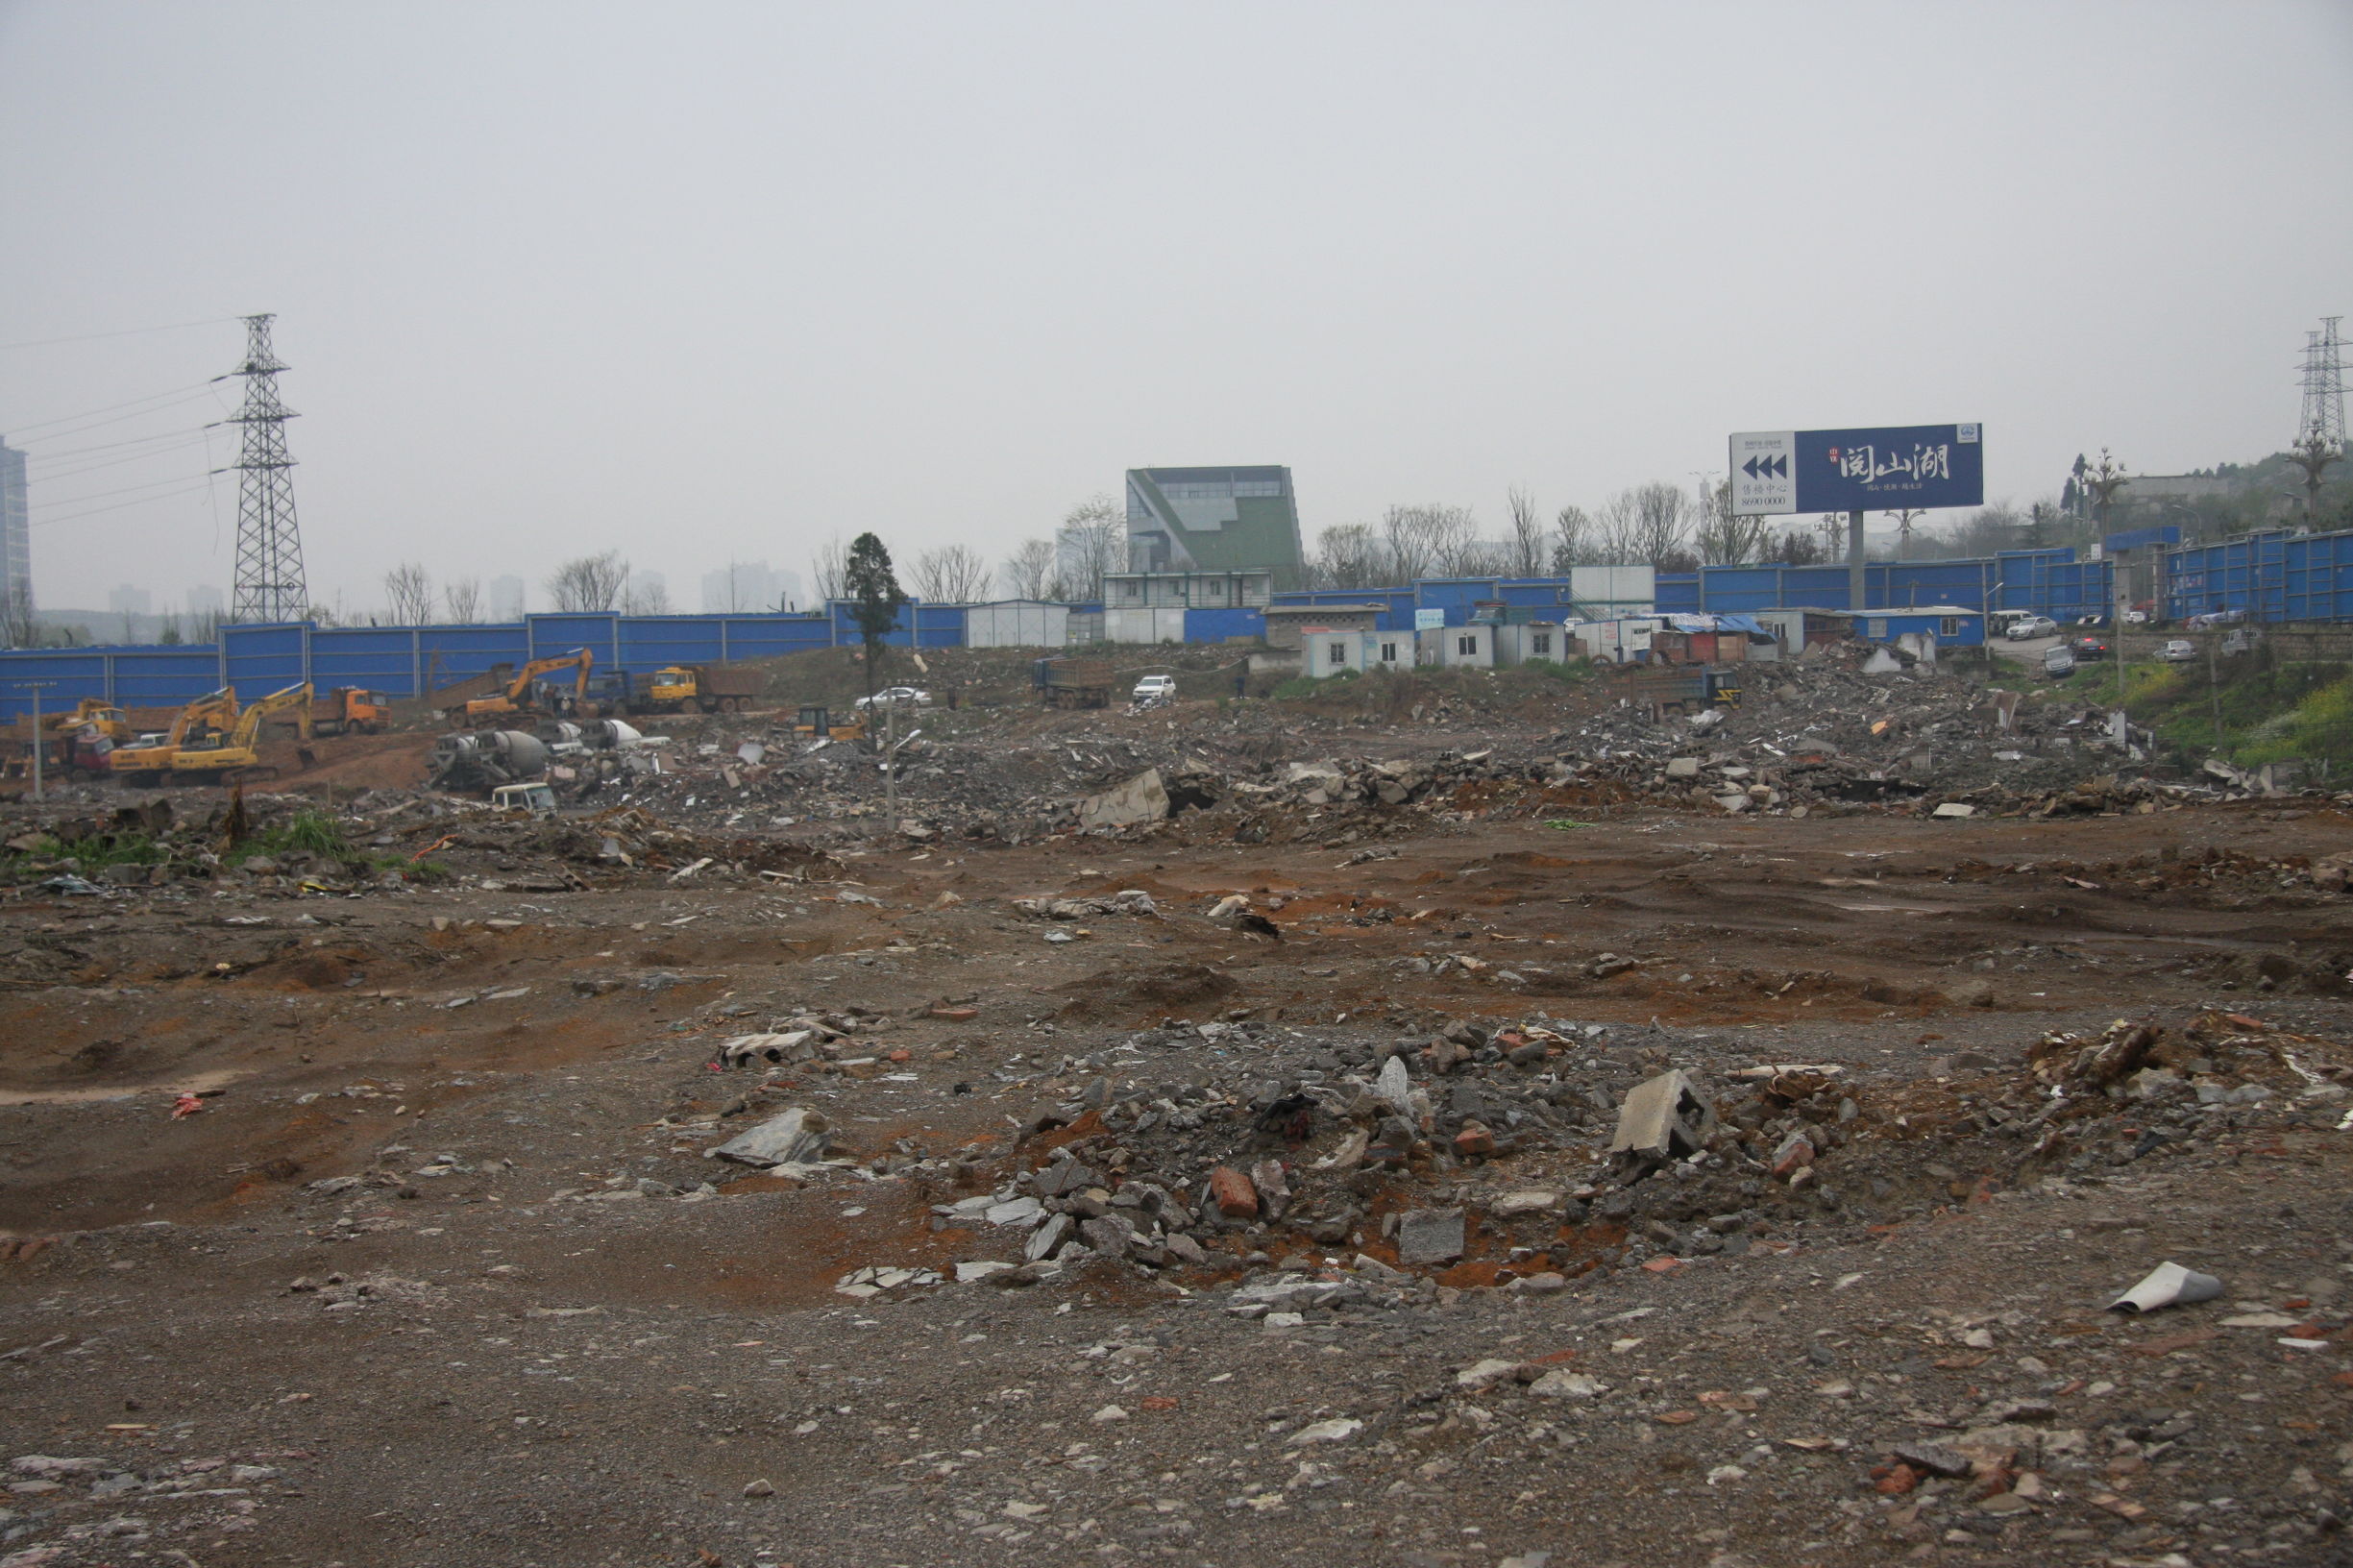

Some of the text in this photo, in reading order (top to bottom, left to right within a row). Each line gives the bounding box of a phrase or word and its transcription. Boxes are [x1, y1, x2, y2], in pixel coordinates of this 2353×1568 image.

[1840, 444, 1949, 483] 阅山湖
[1764, 497, 1786, 505] 0000
